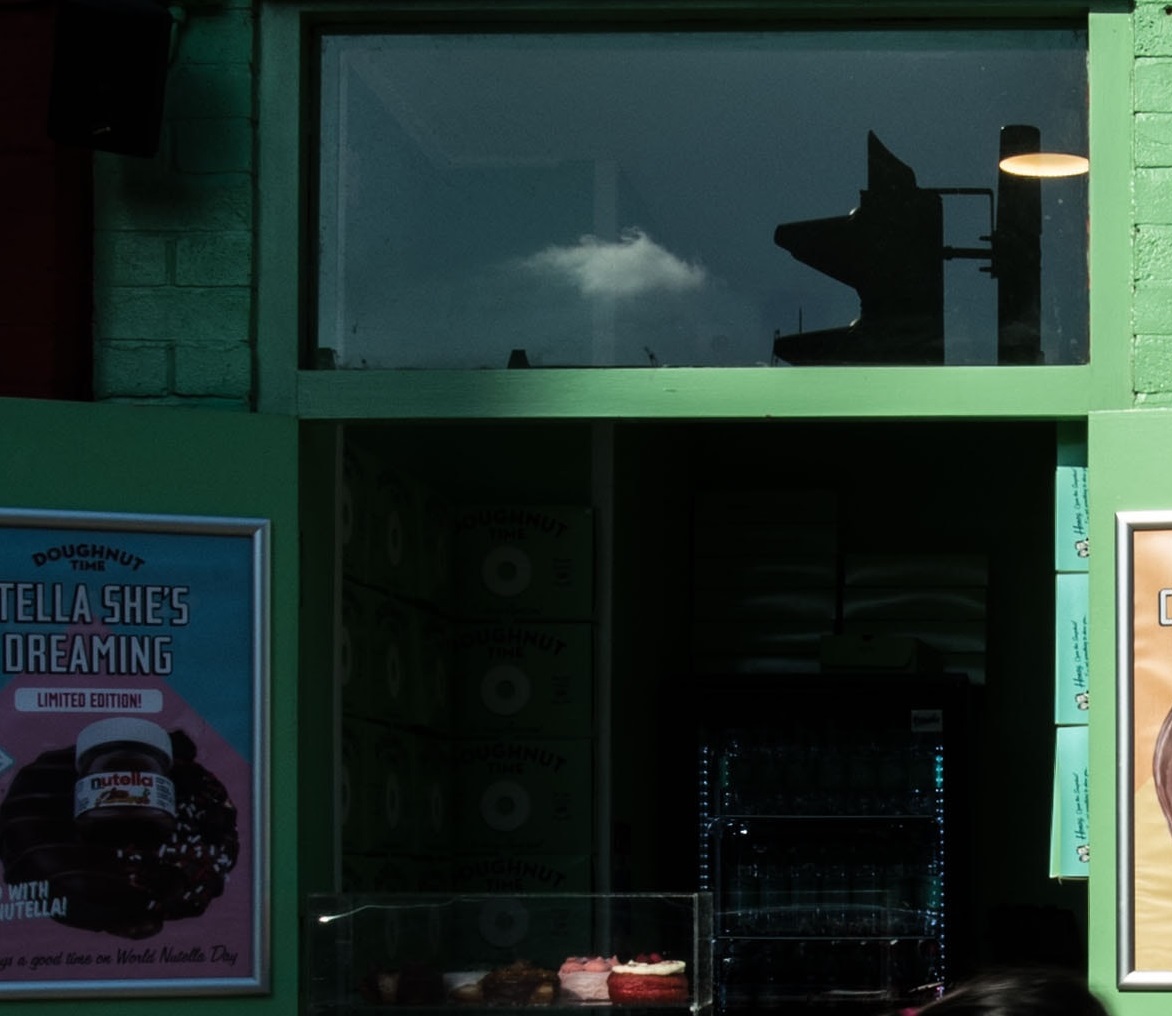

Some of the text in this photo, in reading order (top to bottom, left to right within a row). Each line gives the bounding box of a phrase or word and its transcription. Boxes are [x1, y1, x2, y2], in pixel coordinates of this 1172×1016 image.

[32, 544, 145, 571] DOUGHNUT
[70, 560, 105, 571] TIME
[0, 581, 190, 626] TELLA SHE'S
[3, 632, 174, 676] DREAMING
[37, 692, 142, 709] LIMITED EDITION!
[91, 770, 154, 790] nutella
[8, 880, 49, 901] WITH
[17, 956, 28, 966] a
[30, 951, 63, 971] good
[65, 952, 92, 966] time
[96, 955, 112, 965] on
[116, 948, 156, 965] World
[159, 946, 206, 965] Nutella
[210, 944, 238, 967] Day
